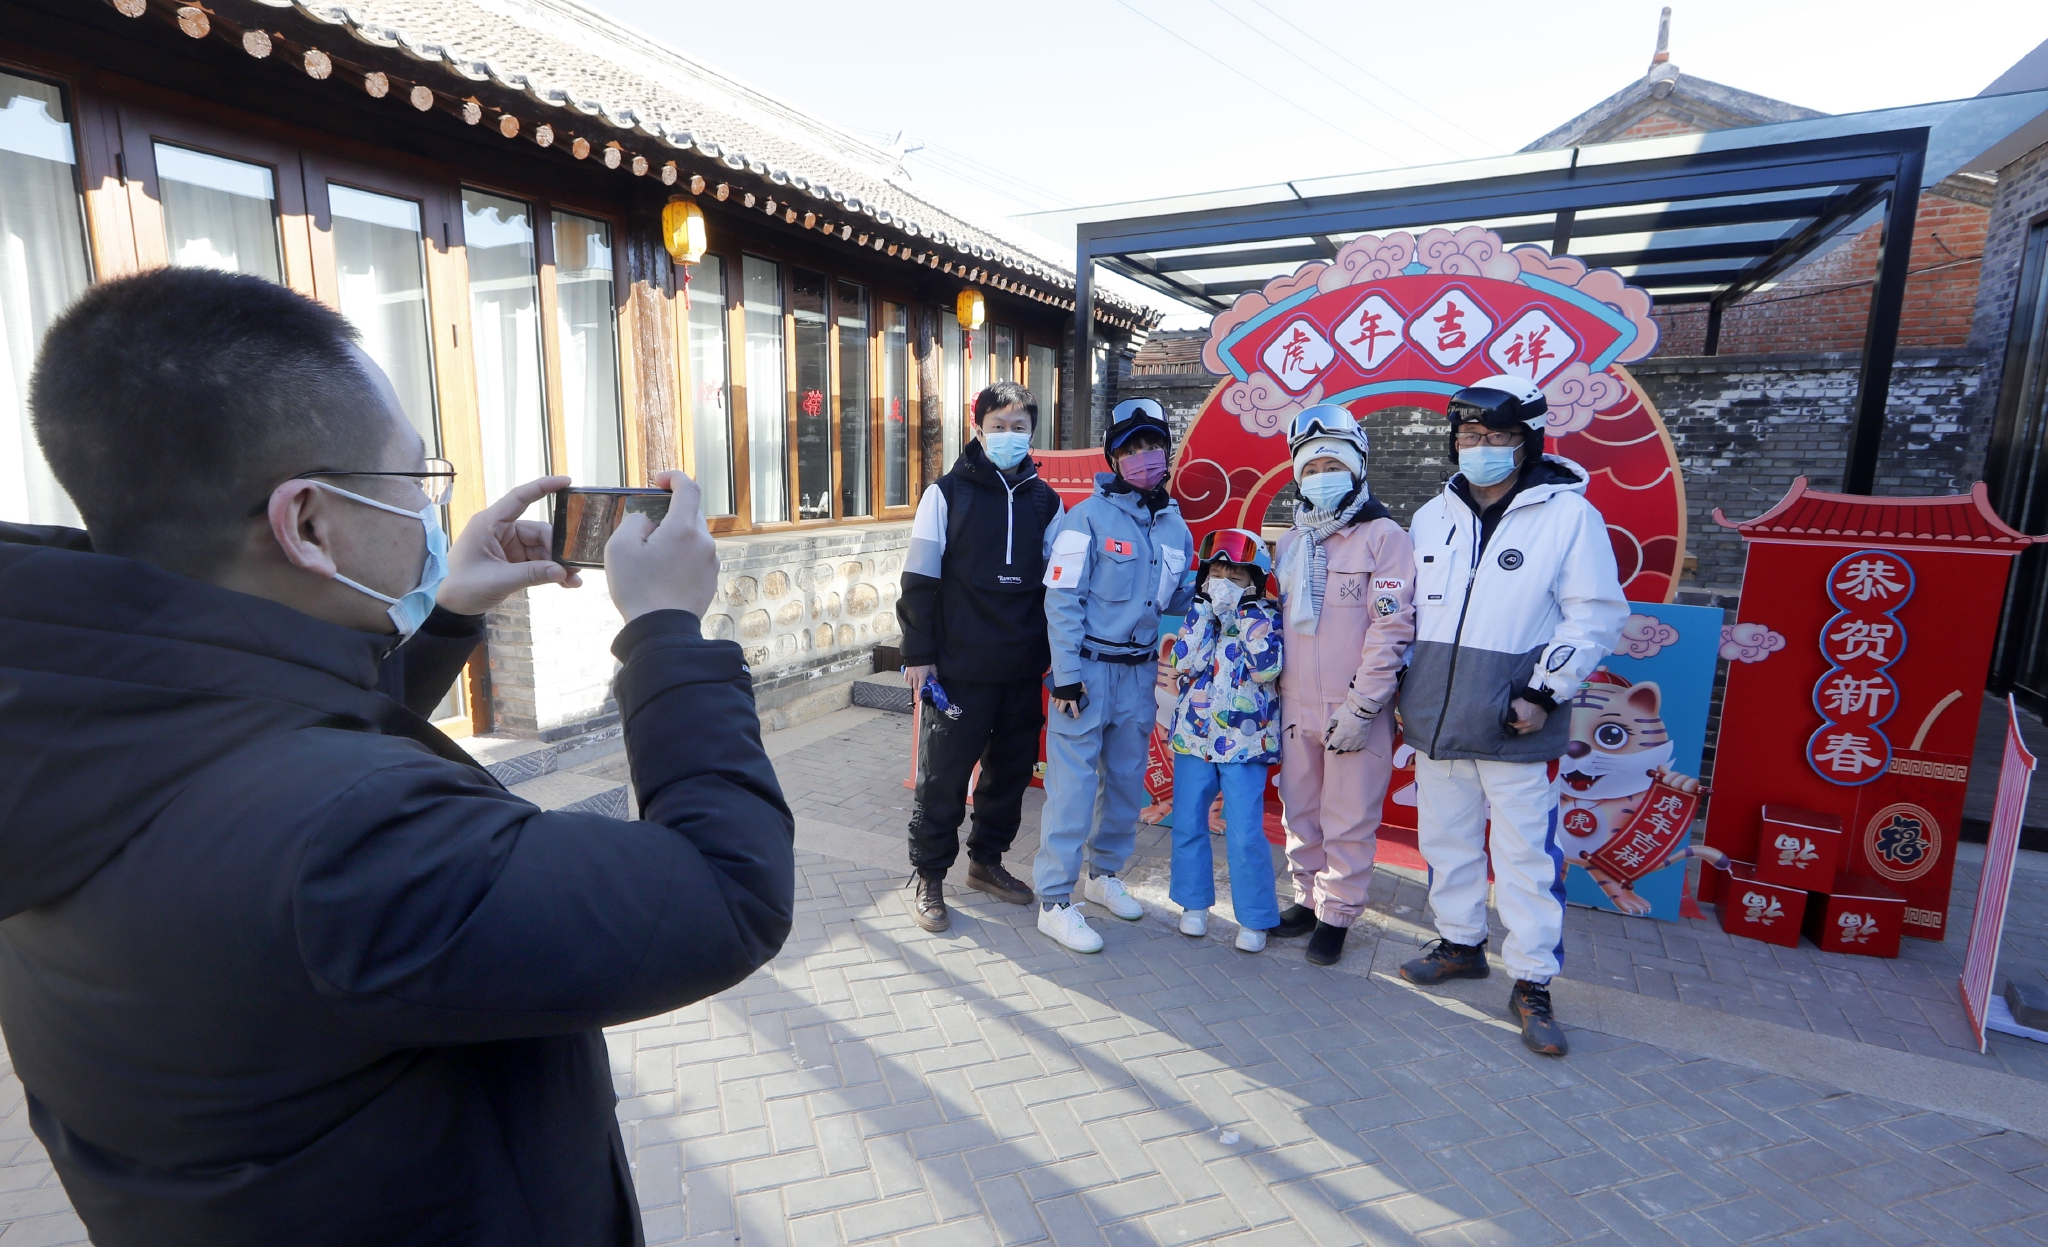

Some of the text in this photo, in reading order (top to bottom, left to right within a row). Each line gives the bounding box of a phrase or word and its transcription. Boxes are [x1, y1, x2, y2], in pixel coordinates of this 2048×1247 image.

[1280, 300, 1555, 380] 虎年吉祥
[1375, 580, 1402, 589] NASA
[1815, 559, 1905, 774] 恭贺新春
[1565, 812, 1593, 833] 虎
[1613, 795, 1683, 868] 虎年吉祥
[1874, 814, 1931, 865] 福
[1774, 833, 1819, 869] 福
[1742, 890, 1785, 926] 福
[1837, 911, 1879, 944] 福
